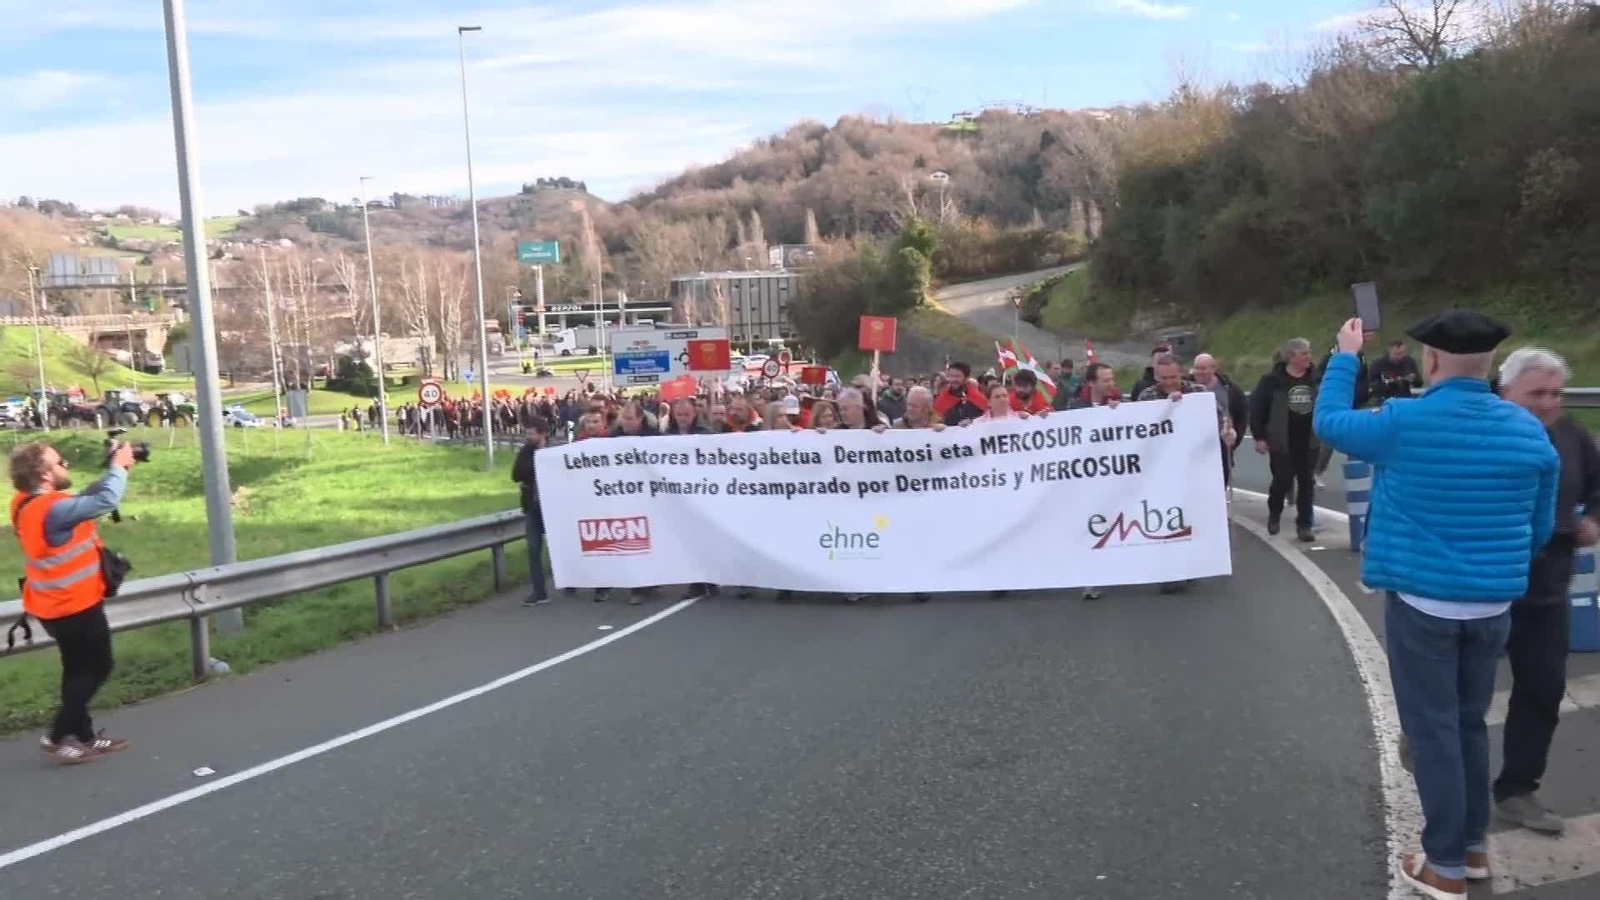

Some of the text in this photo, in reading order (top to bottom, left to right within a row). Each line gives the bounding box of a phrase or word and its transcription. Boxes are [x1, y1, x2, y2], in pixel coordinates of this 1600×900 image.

[423, 390, 438, 399] 40
[563, 418, 1174, 471] Lehen sektorea babesgabetua Dermatosi eta MERCOSUR aurrean
[593, 453, 1142, 500] Sector primario desamparado por Dermatosis y MERCOSUR
[579, 518, 647, 541] UAGN
[819, 526, 880, 549] ehne
